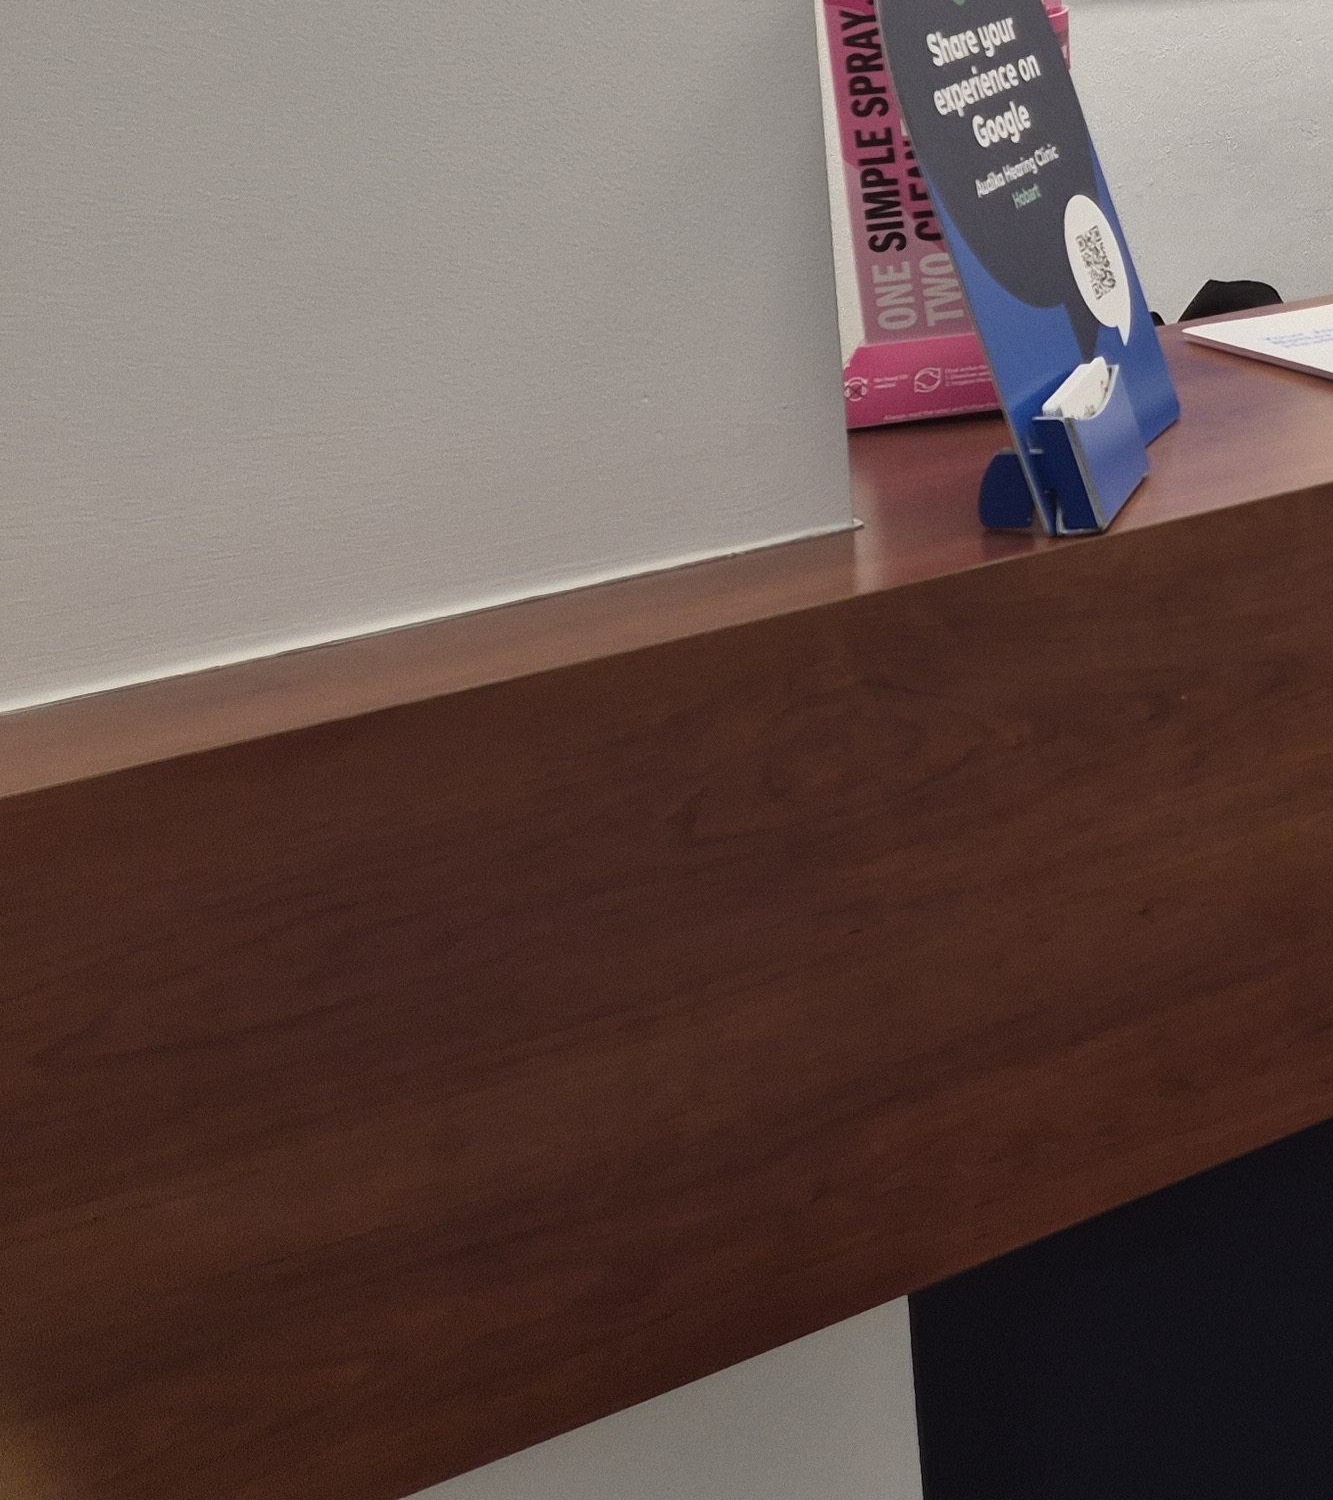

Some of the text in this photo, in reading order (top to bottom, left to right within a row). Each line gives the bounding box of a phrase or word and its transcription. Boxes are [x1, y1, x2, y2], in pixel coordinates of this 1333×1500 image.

[926, 17, 1016, 67] Share your
[933, 54, 1042, 117] experience on
[972, 101, 1032, 148] Google
[855, 127, 907, 253] SIMPLE
[975, 143, 1060, 198] Audika Hearing Clinic
[1011, 183, 1042, 209] Hobart
[872, 260, 918, 331] ONE
[919, 252, 966, 327] TWO
